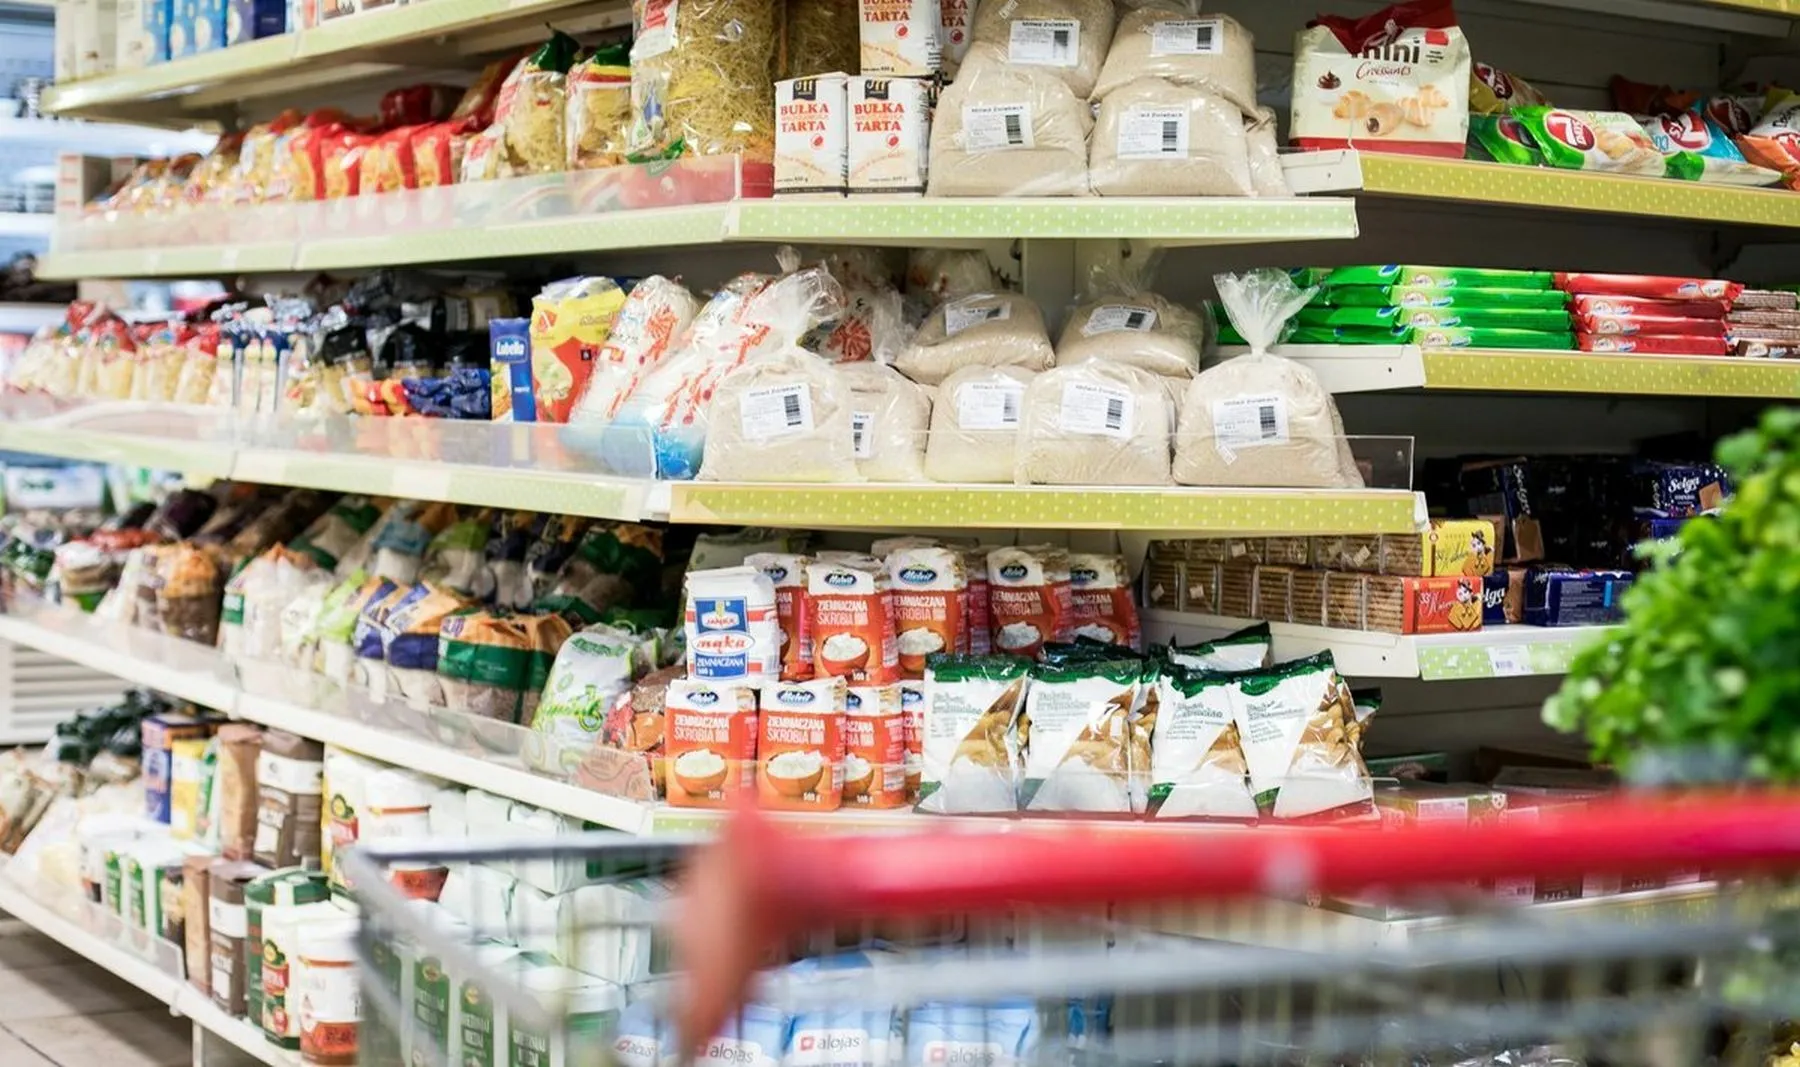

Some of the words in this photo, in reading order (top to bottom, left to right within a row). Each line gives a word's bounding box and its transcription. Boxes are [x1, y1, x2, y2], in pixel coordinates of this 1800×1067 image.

[863, 11, 910, 22] TARTA
[1355, 61, 1412, 80] Croissants
[779, 102, 830, 114] BUŁKA
[853, 102, 905, 114] BUŁKA
[781, 120, 826, 133] TARTA
[855, 120, 903, 132] TARTA
[496, 340, 525, 356] Lubella
[1667, 476, 1700, 494] Selga
[696, 635, 747, 655] mąka
[816, 1032, 860, 1050] alojas
[709, 1043, 755, 1064] alojas
[950, 1047, 996, 1066] alojas
